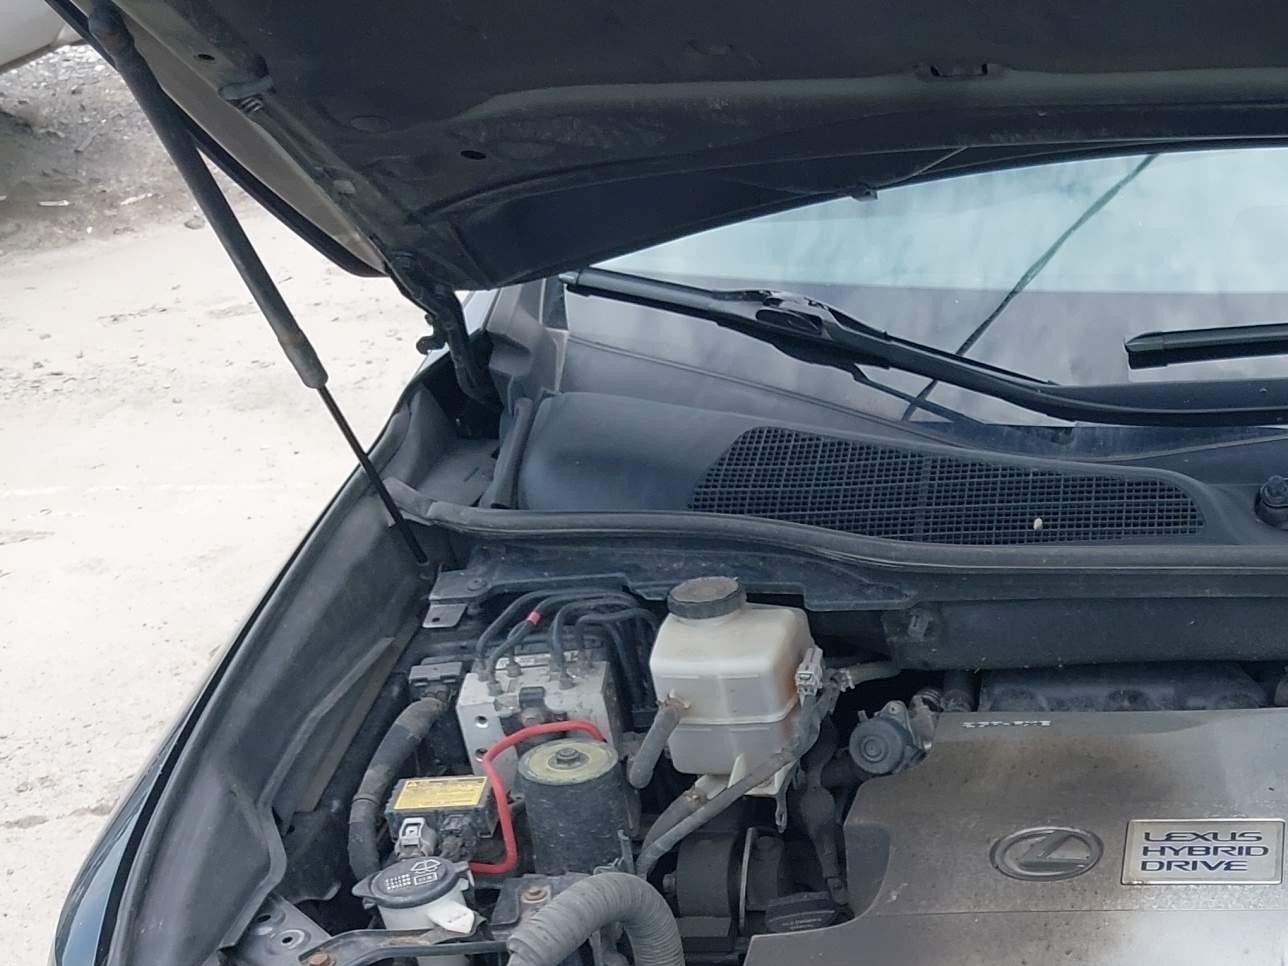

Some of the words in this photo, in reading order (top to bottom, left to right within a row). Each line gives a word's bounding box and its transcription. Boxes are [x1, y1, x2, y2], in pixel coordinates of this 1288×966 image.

[1143, 831, 1263, 842] LEXUS
[1142, 845, 1269, 857] HYBRID
[1140, 860, 1249, 872] DRIVE
